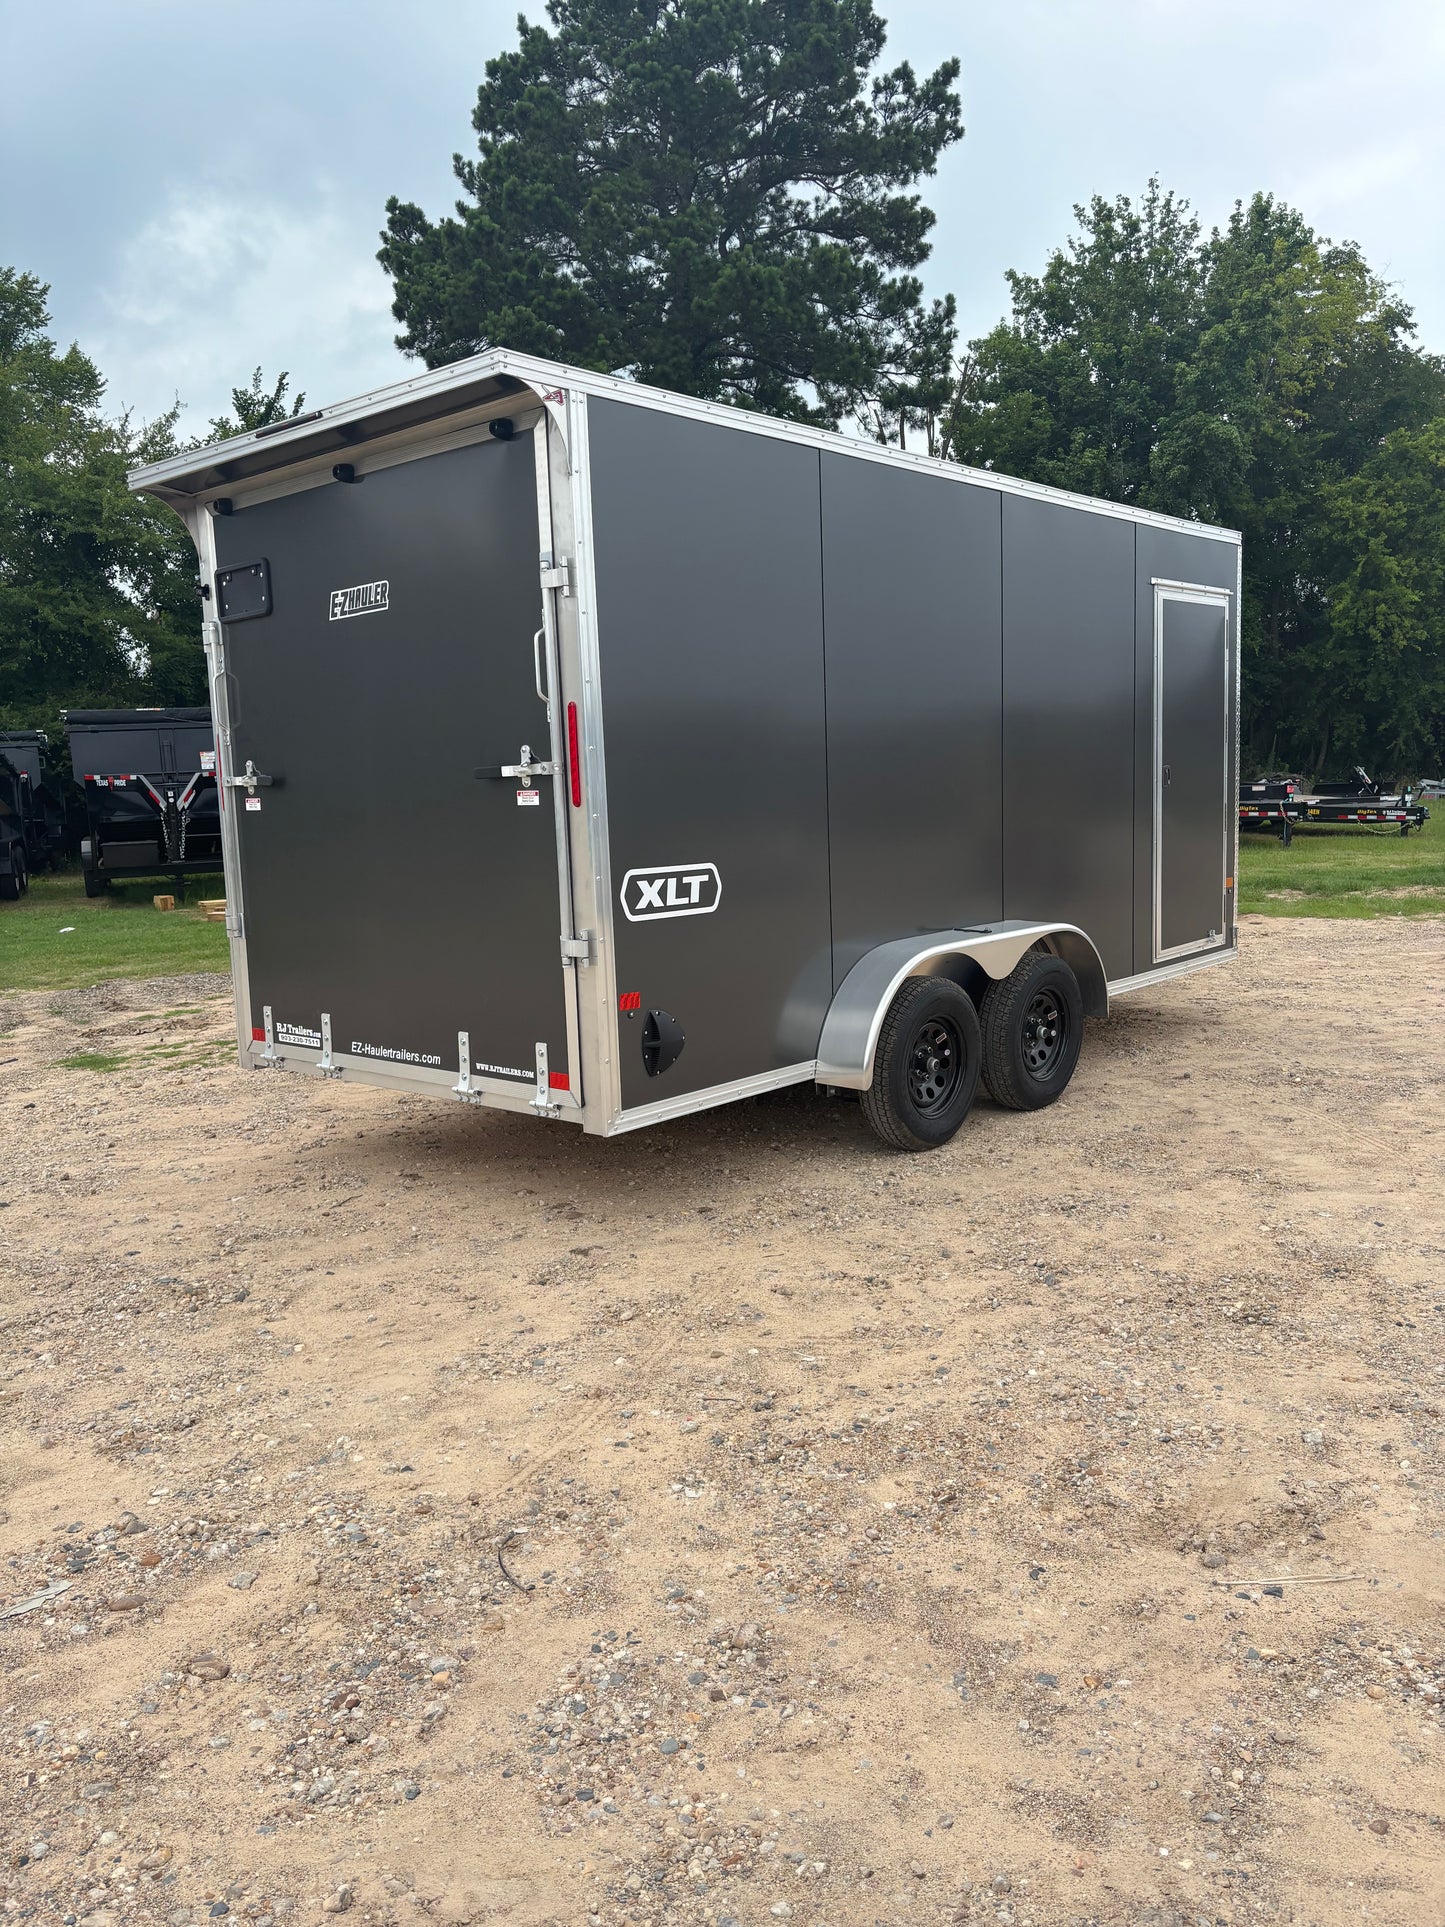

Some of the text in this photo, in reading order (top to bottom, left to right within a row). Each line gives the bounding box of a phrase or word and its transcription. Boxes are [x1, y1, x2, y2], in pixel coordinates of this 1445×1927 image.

[634, 874, 709, 909] XLT
[276, 1022, 287, 1033] RJ
[351, 1041, 441, 1065] EZ-Haulertrailers.com
